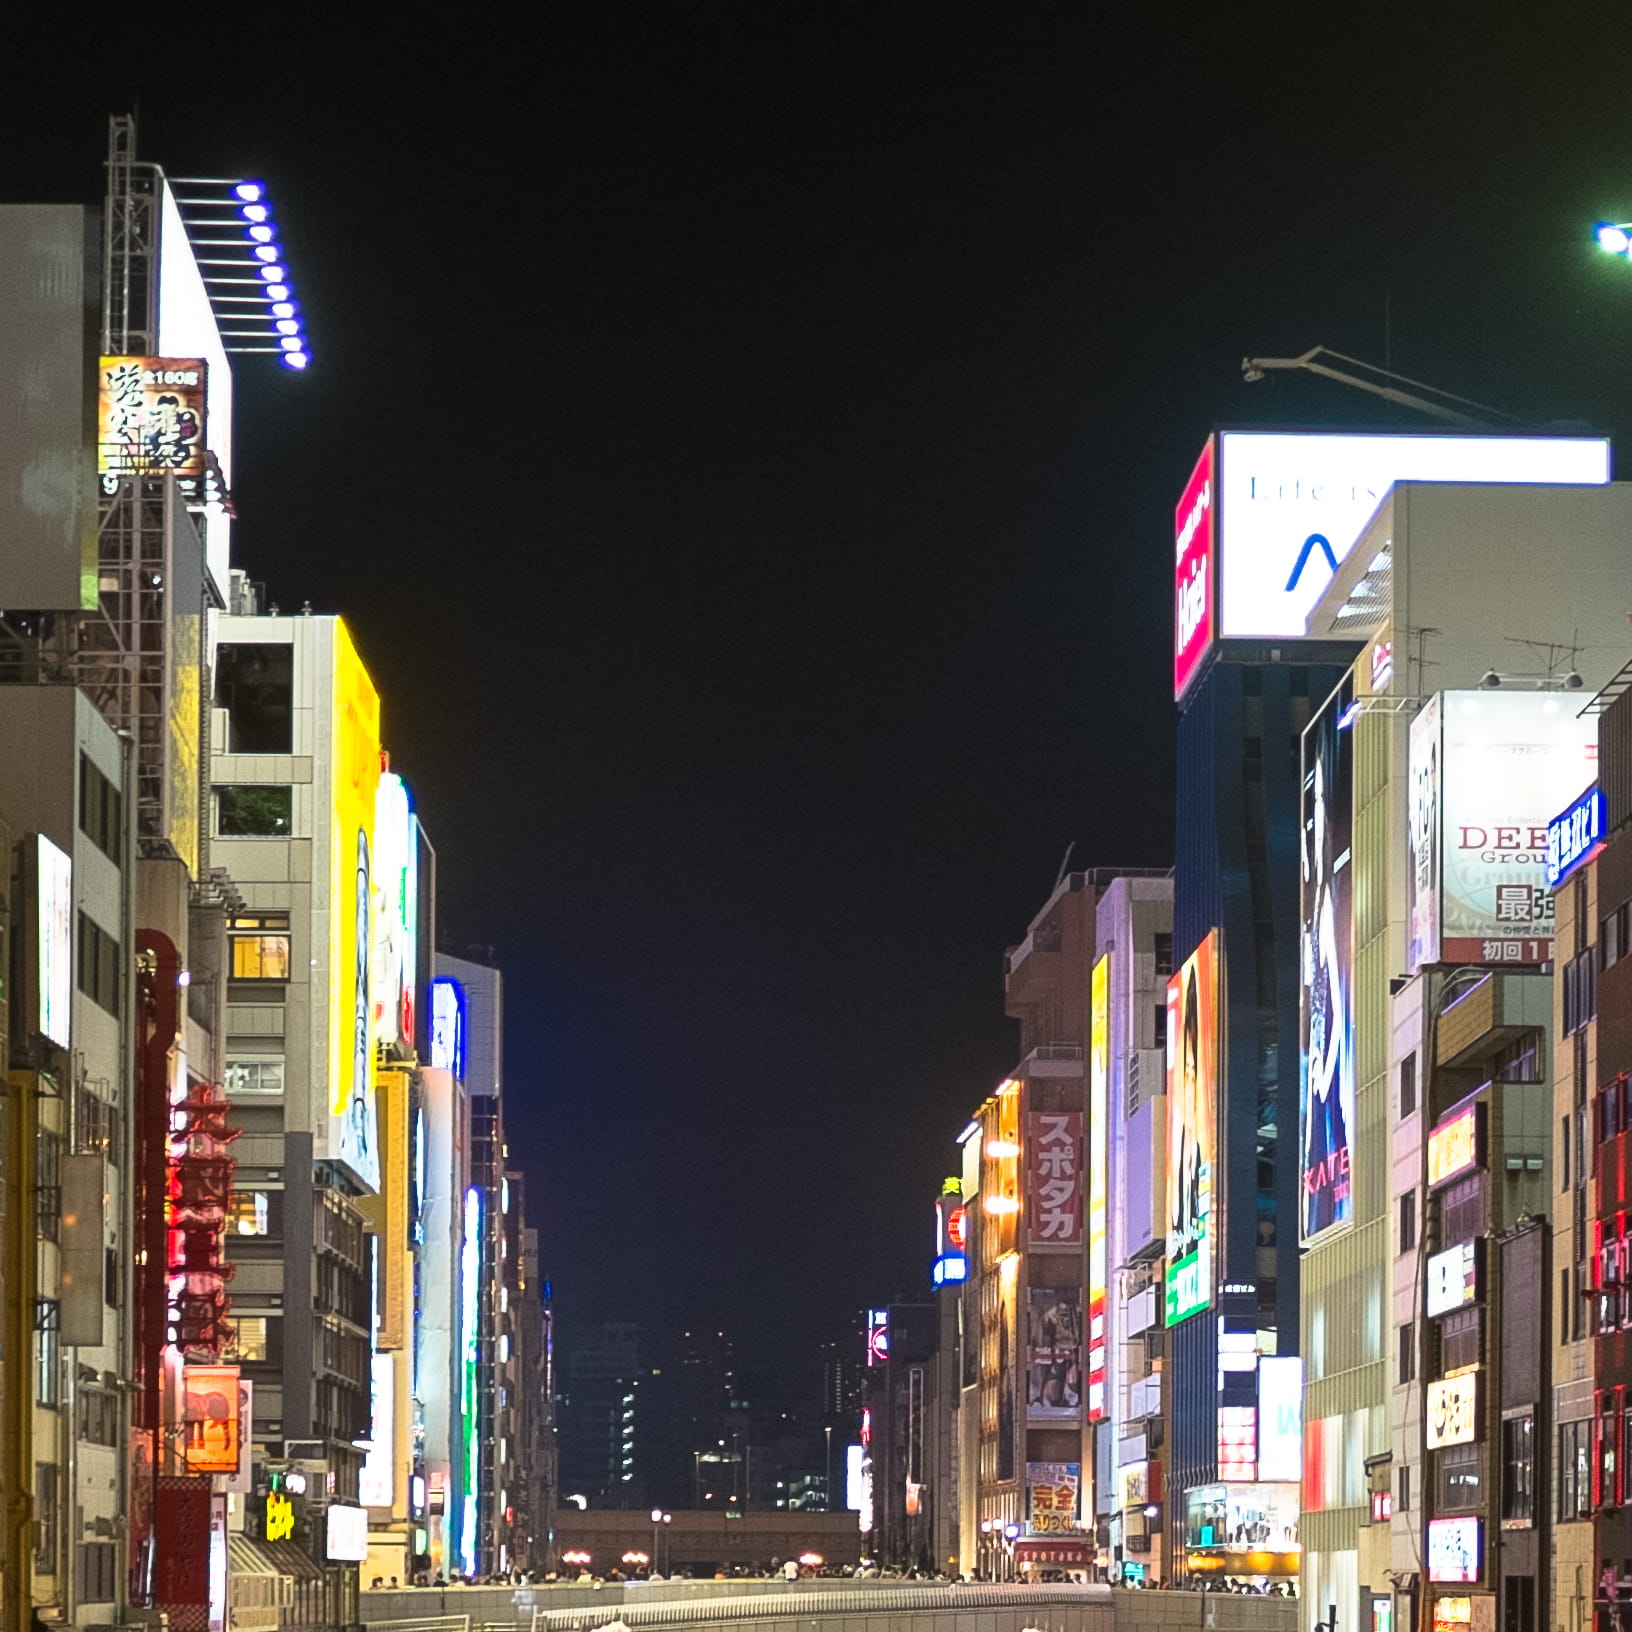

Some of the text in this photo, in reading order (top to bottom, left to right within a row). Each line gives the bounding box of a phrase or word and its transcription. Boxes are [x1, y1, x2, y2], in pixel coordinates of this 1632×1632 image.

[1458, 826, 1550, 849] DEE
[1481, 851, 1548, 864] Grou
[1038, 1116, 1075, 1239] スポタカ
[1303, 1146, 1349, 1194] KATE
[1032, 1484, 1076, 1511] 完全
